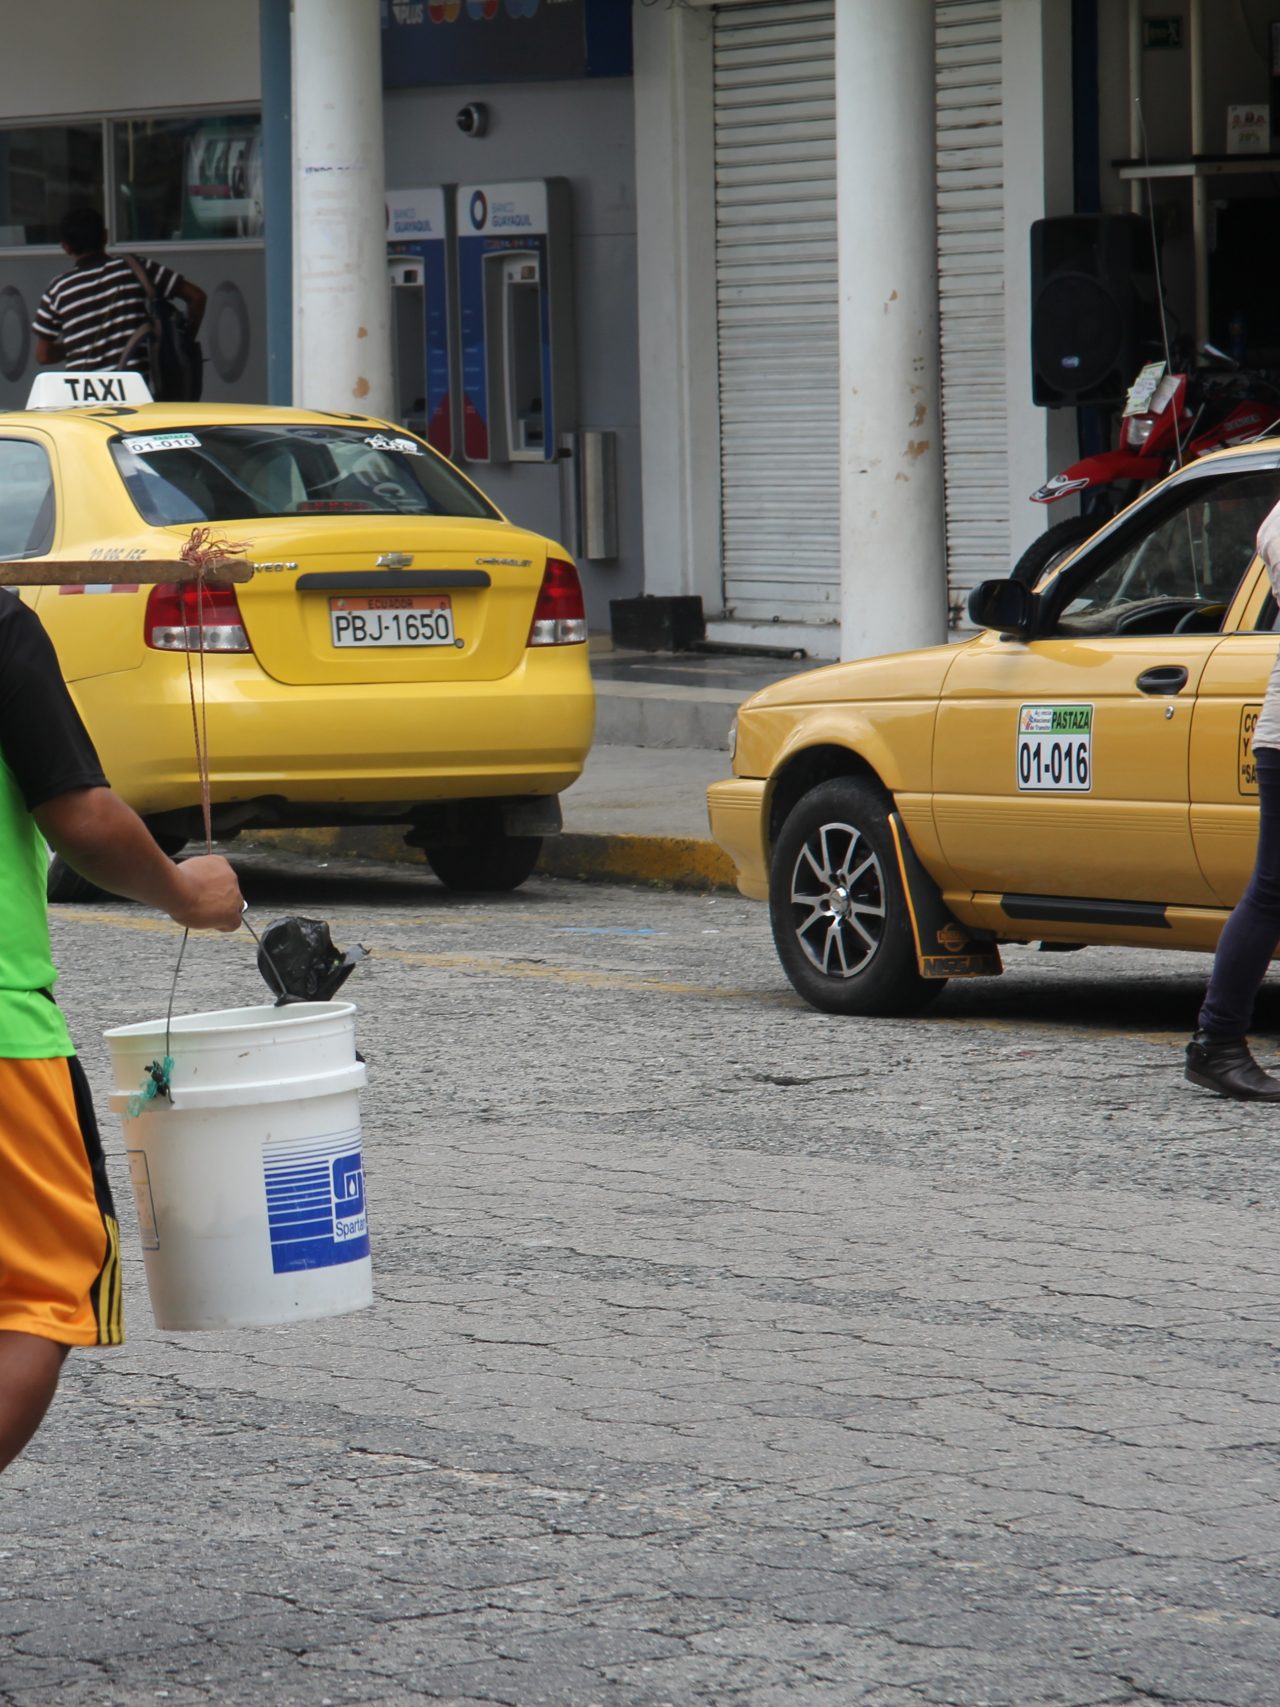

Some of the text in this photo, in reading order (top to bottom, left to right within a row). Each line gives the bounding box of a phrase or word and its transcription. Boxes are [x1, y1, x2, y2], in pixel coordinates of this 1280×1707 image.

[64, 378, 126, 401] TAXI
[131, 438, 196, 453] 01-010
[368, 599, 414, 609] ECUADOR
[336, 614, 450, 643] PBJ-1650
[1052, 711, 1089, 729] PASTAZA
[1020, 742, 1088, 784] 01-016
